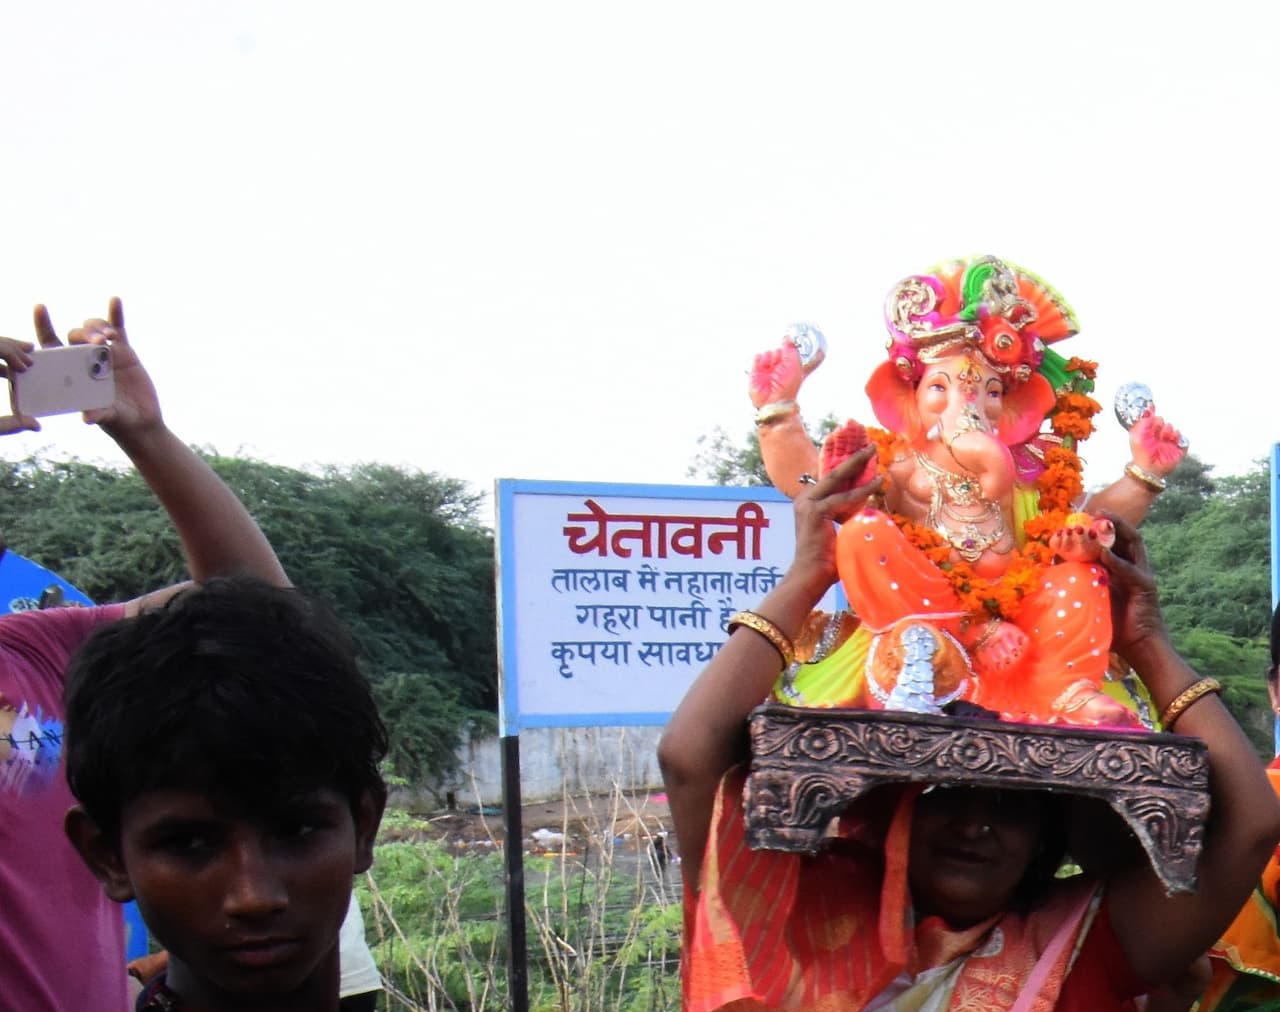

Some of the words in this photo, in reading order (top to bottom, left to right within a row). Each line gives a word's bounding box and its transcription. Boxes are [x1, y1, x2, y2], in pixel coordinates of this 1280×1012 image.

[563, 499, 769, 560] चेतावनी
[551, 569, 631, 594] तालाब
[638, 564, 661, 593] में
[664, 571, 733, 600] नहाना
[734, 566, 784, 594] वर्जि
[576, 604, 642, 634] गहरा
[646, 599, 712, 630] पानी
[551, 641, 632, 678] कृपया
